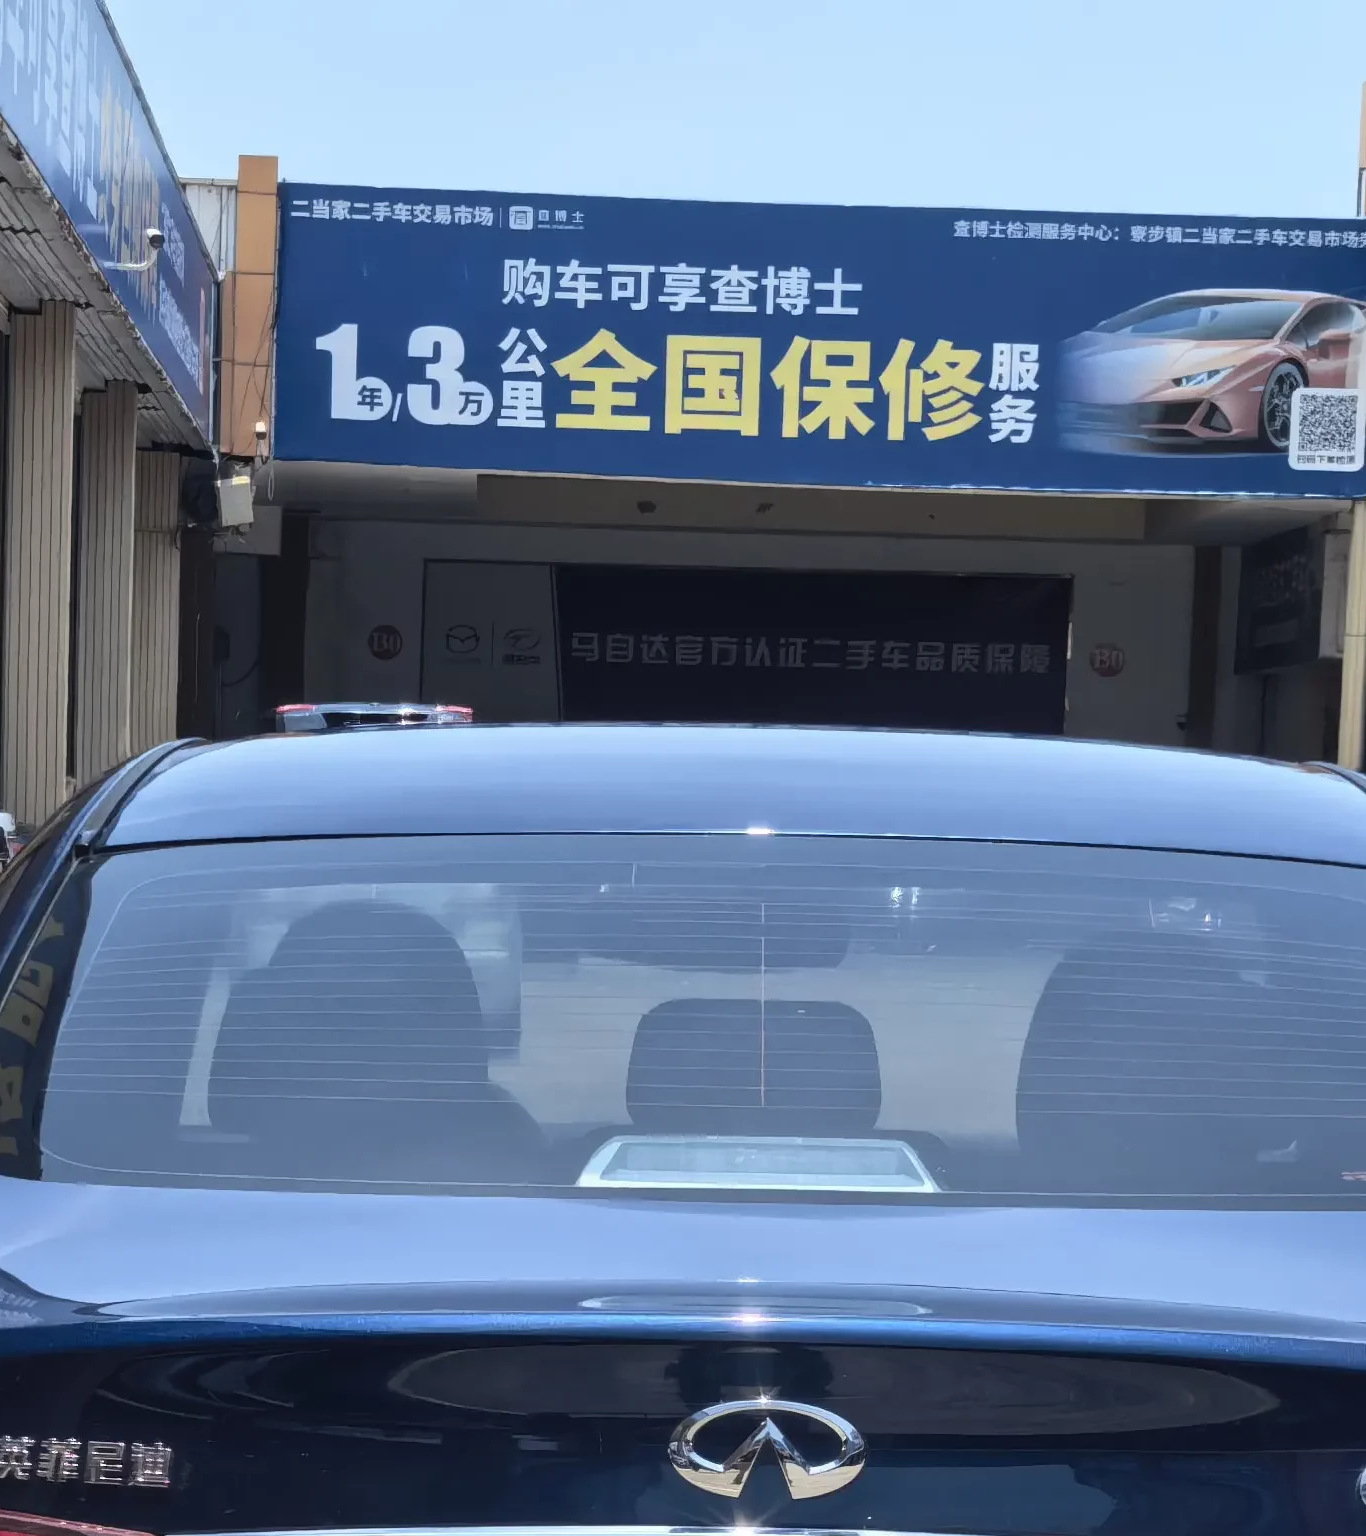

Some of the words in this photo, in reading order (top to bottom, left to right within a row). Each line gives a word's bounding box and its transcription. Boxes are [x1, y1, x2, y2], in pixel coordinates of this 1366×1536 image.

[290, 198, 495, 228] 二当家二手车交易市场
[501, 257, 863, 317] 购车可享查博士
[550, 328, 986, 443] 全国保修
[570, 630, 1053, 677] 马自达官方认证二手车品质保障
